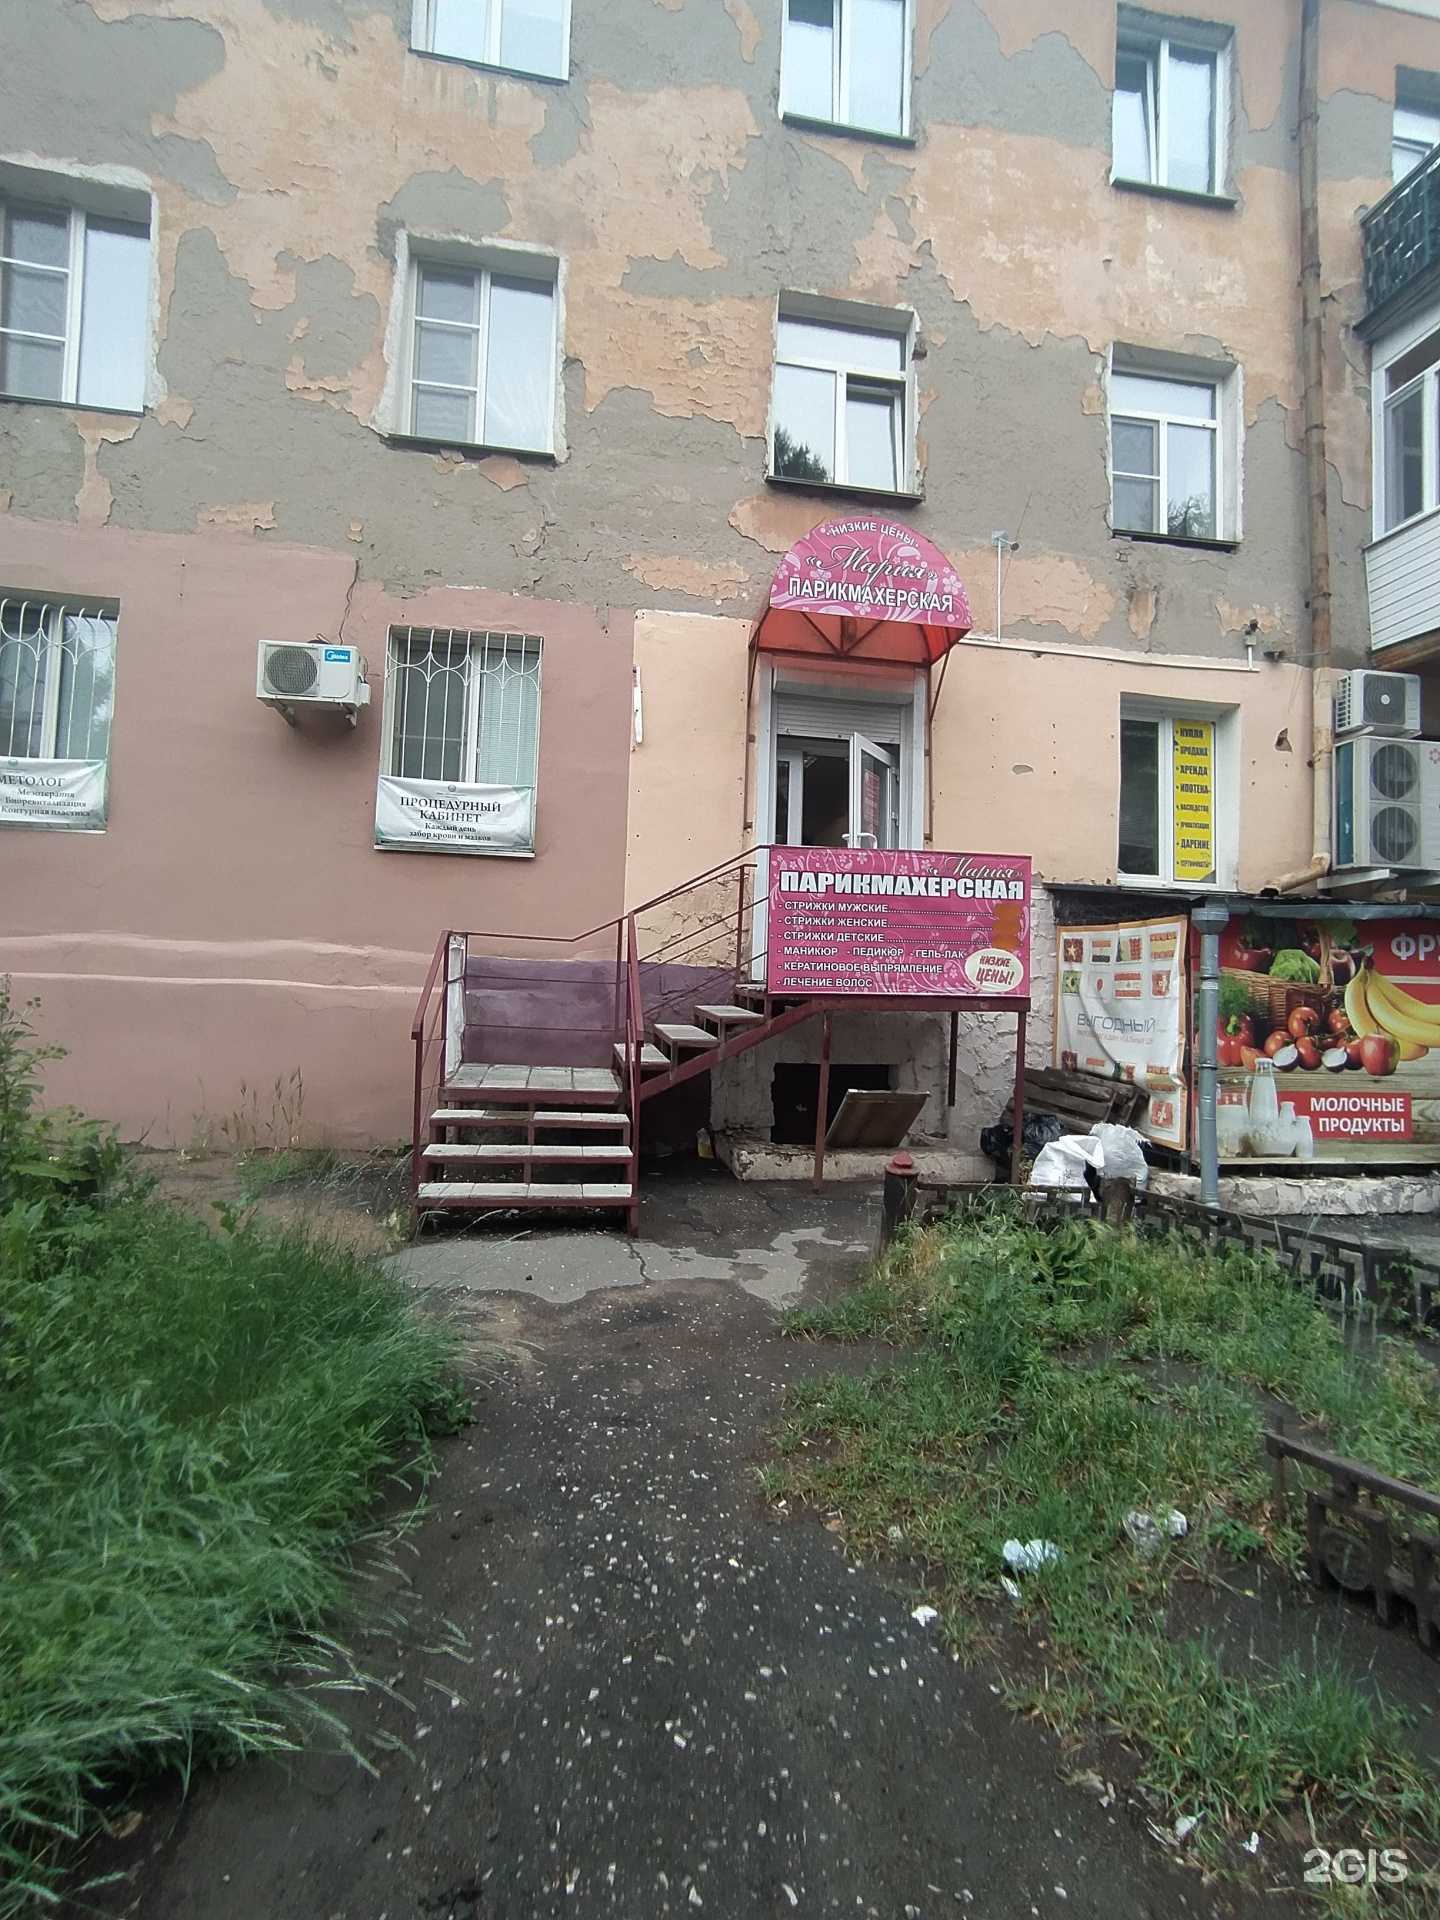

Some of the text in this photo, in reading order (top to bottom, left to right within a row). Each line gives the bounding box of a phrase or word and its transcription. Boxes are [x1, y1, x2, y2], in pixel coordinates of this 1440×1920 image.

[831, 521, 915, 546] НИЗКИЕ ЦЕНЫ
[788, 576, 954, 613] ПАРИКМАХЕРСКАЯ
[1180, 765, 1208, 776] АРЕНДА
[400, 796, 502, 812] ПРОЦЕДУРНЫЙ
[420, 809, 482, 823] КАБИНЕТ
[1181, 839, 1210, 850] ДАРЕНИЕ
[780, 871, 1024, 900] ПАРИКМАХЕРСКАЯ
[784, 901, 888, 913] СТРИЖКИ МУЖСКИЕ
[784, 916, 887, 928] СТРИЖКИ ЖЕНСКИЕ
[783, 931, 884, 942] СТРИЖКИ ДЕТСКИЕ
[783, 946, 965, 959] МАНИКЮР ПЕДИКЮР ГЕЛЬ-ЛАК
[784, 962, 943, 974] КЕРАТИНОВОЕ ВЫПРЯМЛЕНИЕ
[979, 955, 1012, 968] НИЗКИЕ
[783, 977, 873, 988] ЛЕЧЕНИЕ ВОЛОС
[976, 967, 1015, 986] ЦЕНЫ!
[1310, 1097, 1405, 1112] МОЛОЧНЫЕ
[1319, 1117, 1405, 1135] ПРОДУКТЫ
